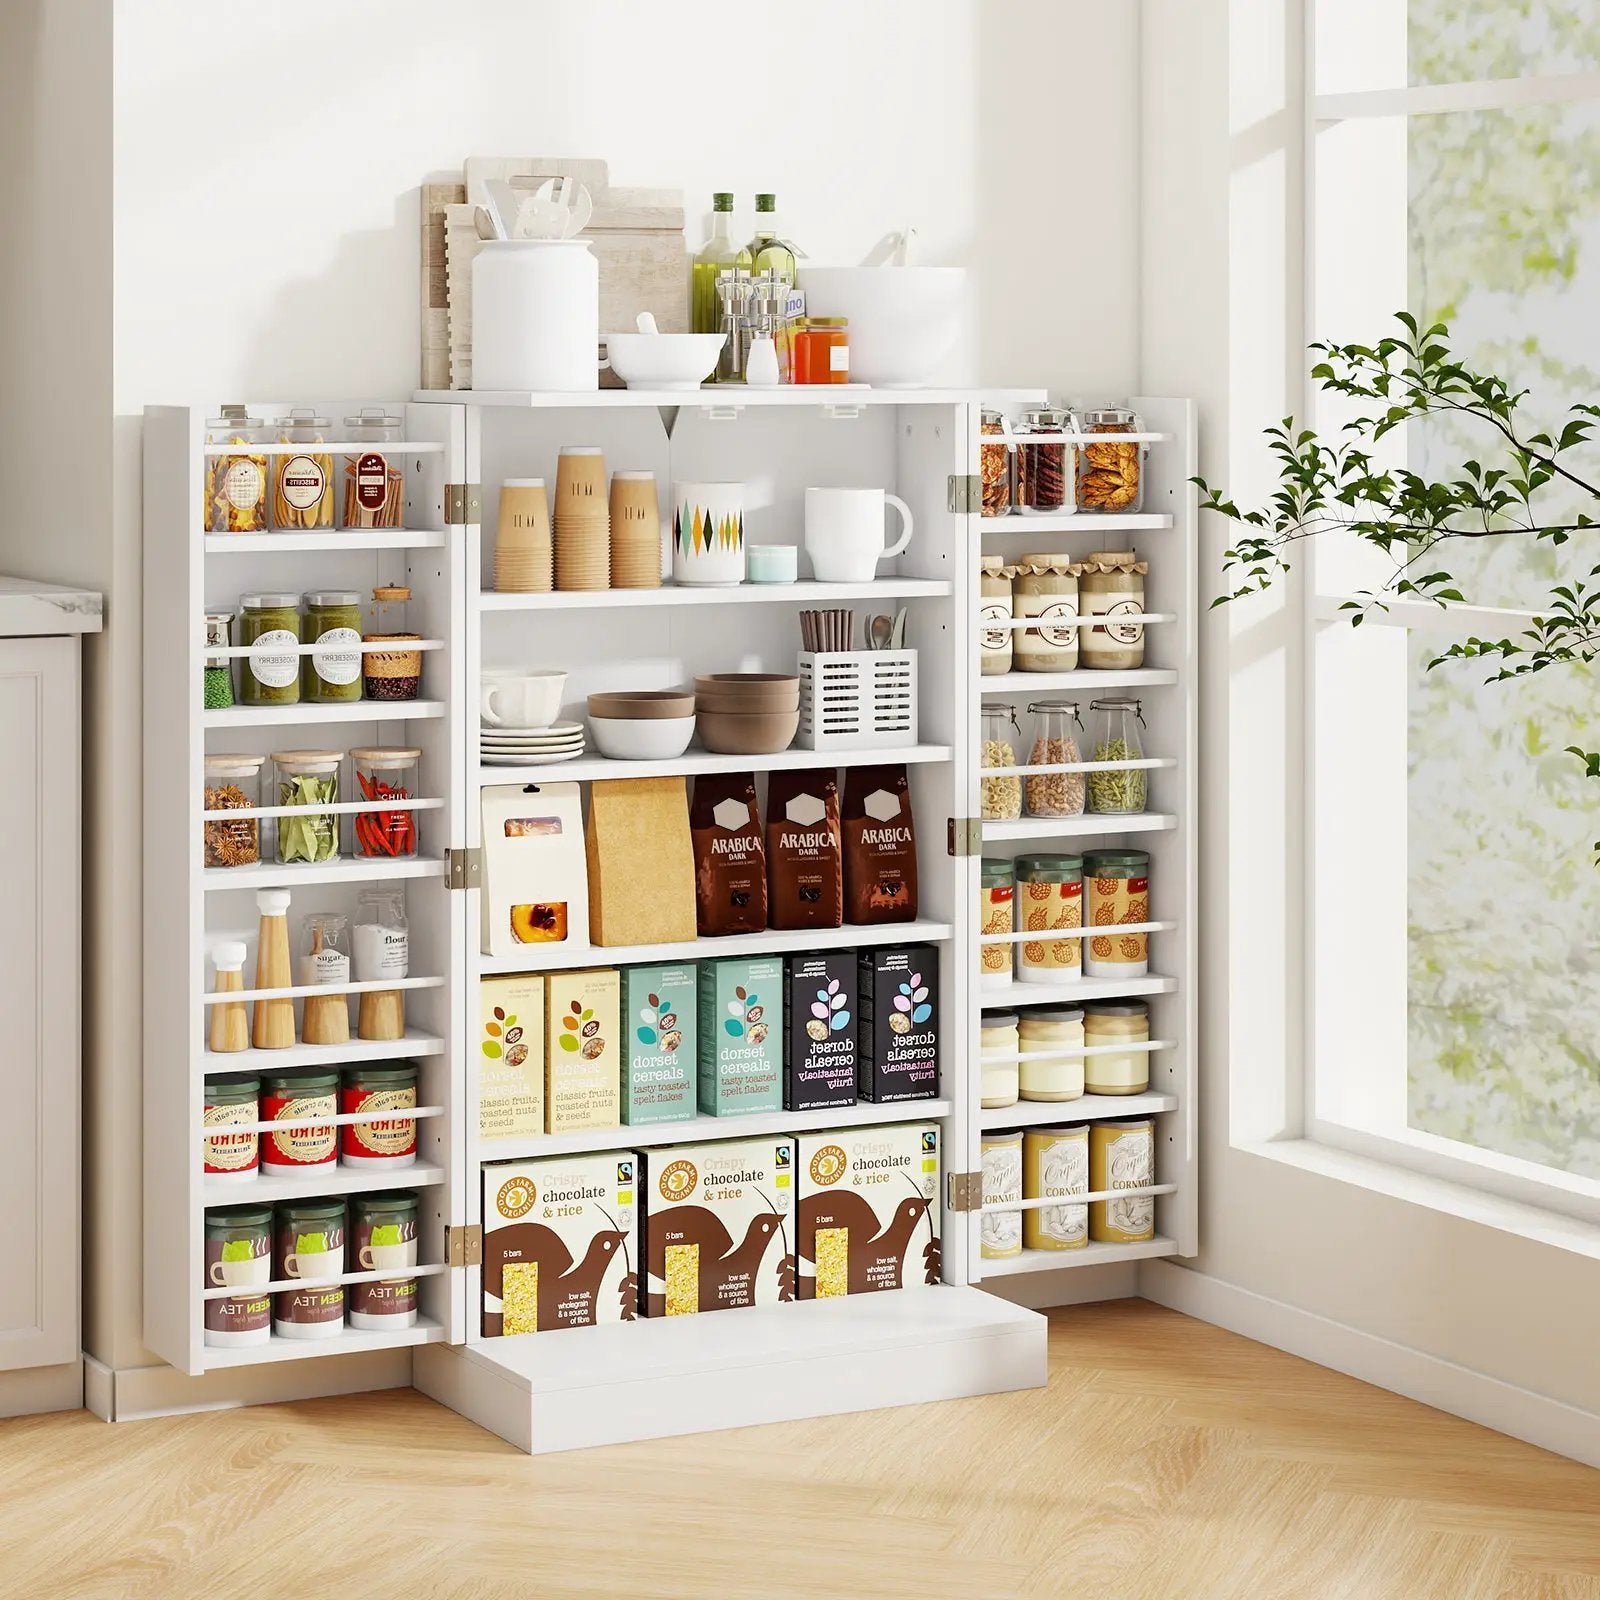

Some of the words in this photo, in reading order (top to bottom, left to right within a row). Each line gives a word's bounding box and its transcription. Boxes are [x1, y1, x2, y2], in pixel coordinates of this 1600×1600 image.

[779, 832, 837, 849] ARABICA
[861, 827, 912, 844] ARABICA
[711, 836, 761, 854] ARABICA
[798, 848, 819, 856] DARK
[878, 843, 897, 851] DARK
[728, 853, 747, 861] DARK
[384, 935, 406, 945] flour
[721, 1045, 765, 1061] dorset
[633, 1053, 679, 1069] dorset
[720, 1059, 771, 1075] cereals
[633, 1067, 684, 1083] cereals
[721, 1076, 743, 1086] tasty
[745, 1072, 777, 1082] toasted
[633, 1085, 656, 1095] tasty
[657, 1081, 690, 1091] toasted
[721, 1086, 743, 1098] spelt
[744, 1084, 770, 1094] flakes
[556, 1090, 587, 1101] classic
[633, 1094, 656, 1106] spelt
[657, 1092, 684, 1103] flakes
[515, 1105, 537, 1115] nuts
[556, 1101, 591, 1112] roasted
[592, 1098, 613, 1108] nuts
[565, 1110, 591, 1121] seeds
[488, 1118, 514, 1128] seeds
[827, 1148, 845, 1162] FARM
[852, 1143, 894, 1156] Crispy
[678, 1162, 696, 1177] FARM
[703, 1158, 746, 1171] Crispy
[852, 1155, 911, 1171] chocolate
[543, 1174, 587, 1188] Crispy
[703, 1170, 764, 1186] chocolate
[815, 1165, 845, 1185] ORGANIC
[852, 1174, 863, 1185] &
[866, 1172, 890, 1184] rice
[516, 1179, 534, 1193] FARM
[664, 1180, 696, 1199] ORGANIC
[542, 1187, 606, 1203] chocolate
[703, 1190, 714, 1201] &
[717, 1187, 743, 1200] rice
[501, 1196, 534, 1216] ORGANIC
[542, 1207, 554, 1218] &
[557, 1204, 583, 1217] rice
[820, 1215, 834, 1223] bars
[665, 1232, 670, 1240] 5
[670, 1231, 684, 1239] bars
[503, 1250, 508, 1258] 5
[508, 1249, 522, 1257] bars
[866, 1264, 896, 1274] wholegrain
[728, 1274, 739, 1282] low
[718, 1282, 748, 1292] wholegrain
[557, 1300, 589, 1311] wholegrain
[736, 1297, 750, 1305] fibre
[570, 1317, 577, 1325] of
[576, 1316, 590, 1324] fibre
